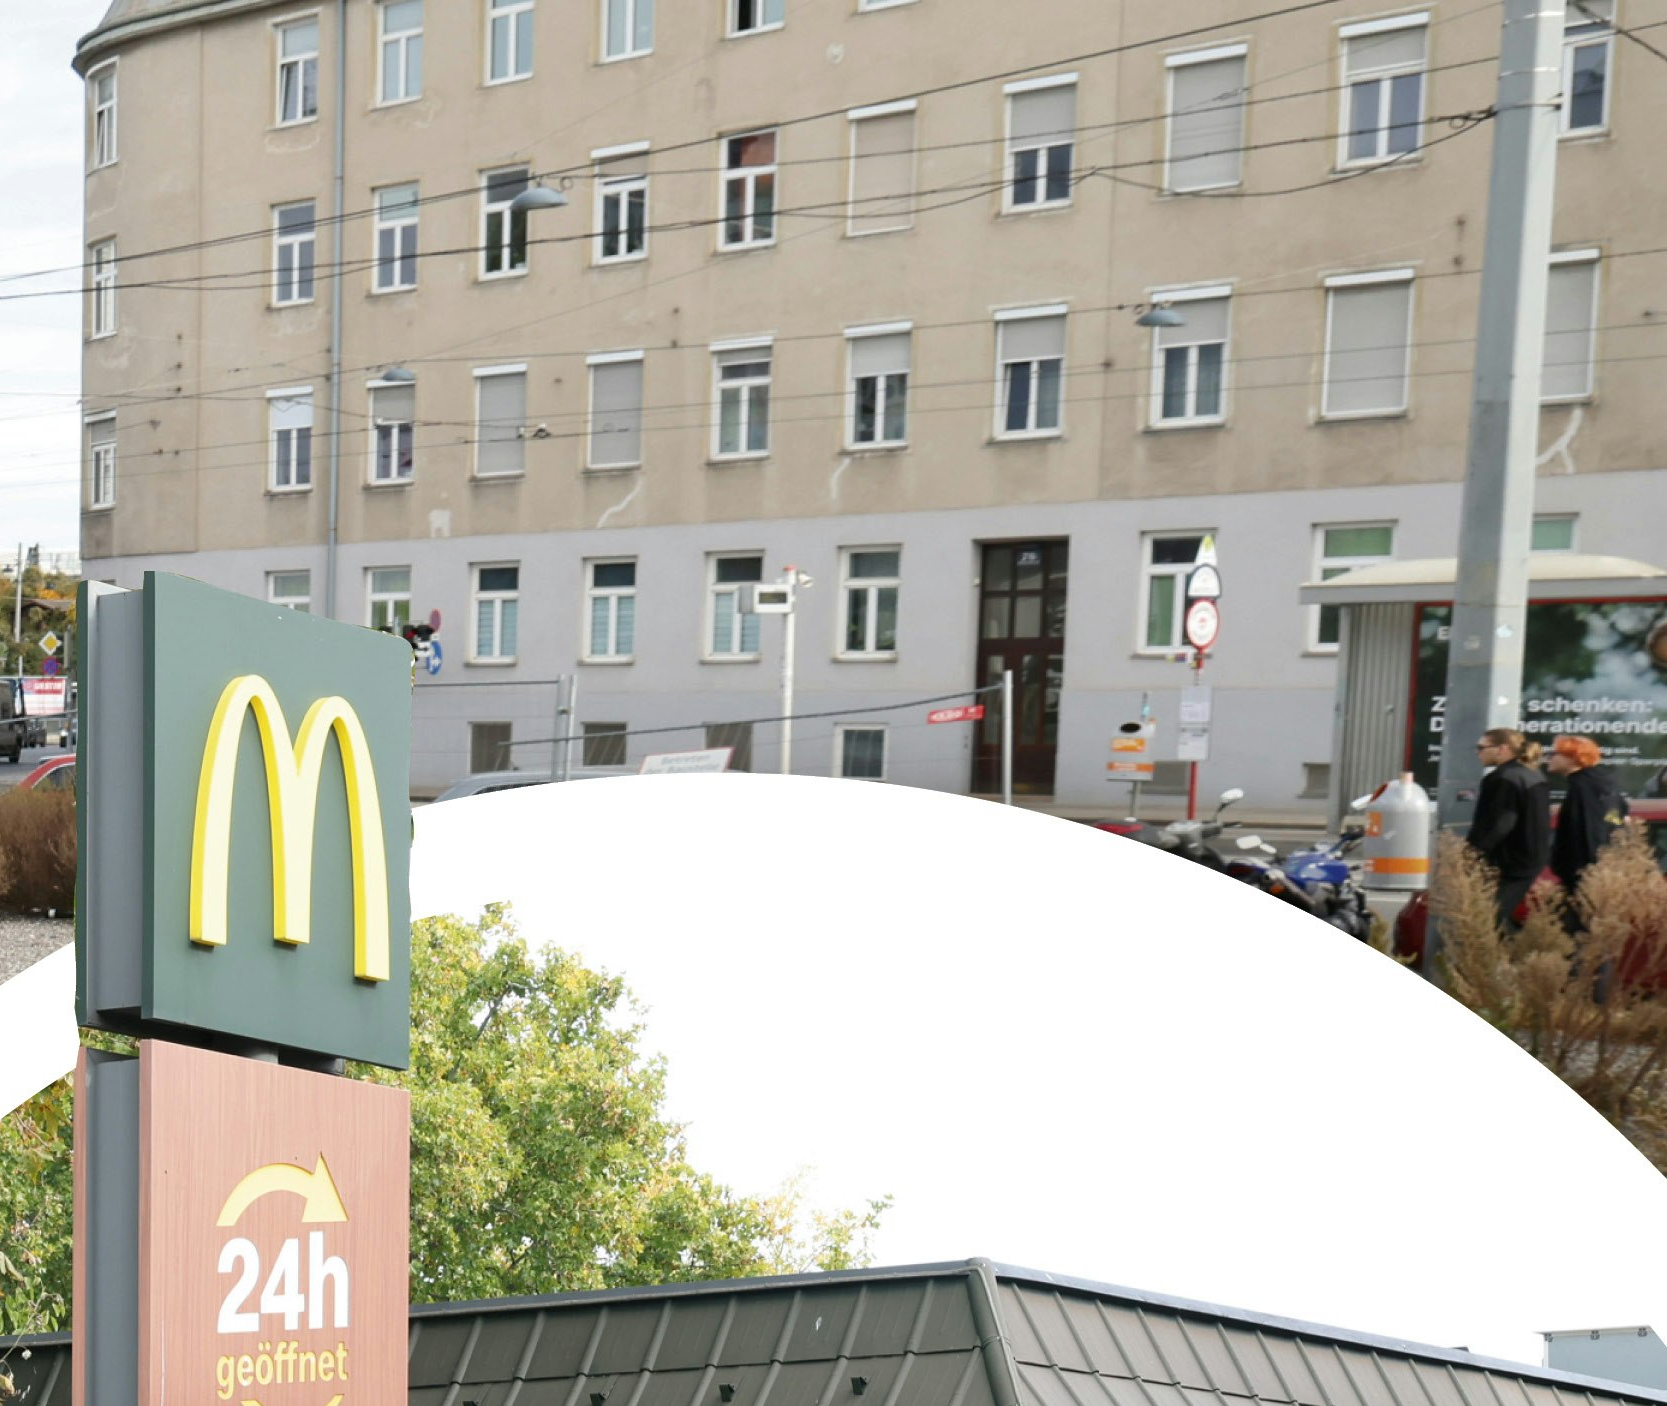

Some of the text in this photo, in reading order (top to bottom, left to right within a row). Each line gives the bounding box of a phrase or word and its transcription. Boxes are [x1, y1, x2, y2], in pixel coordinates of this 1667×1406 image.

[1527, 696, 1653, 714] schenken:
[216, 1230, 350, 1334] 24h
[215, 1340, 349, 1401] geöffnet
